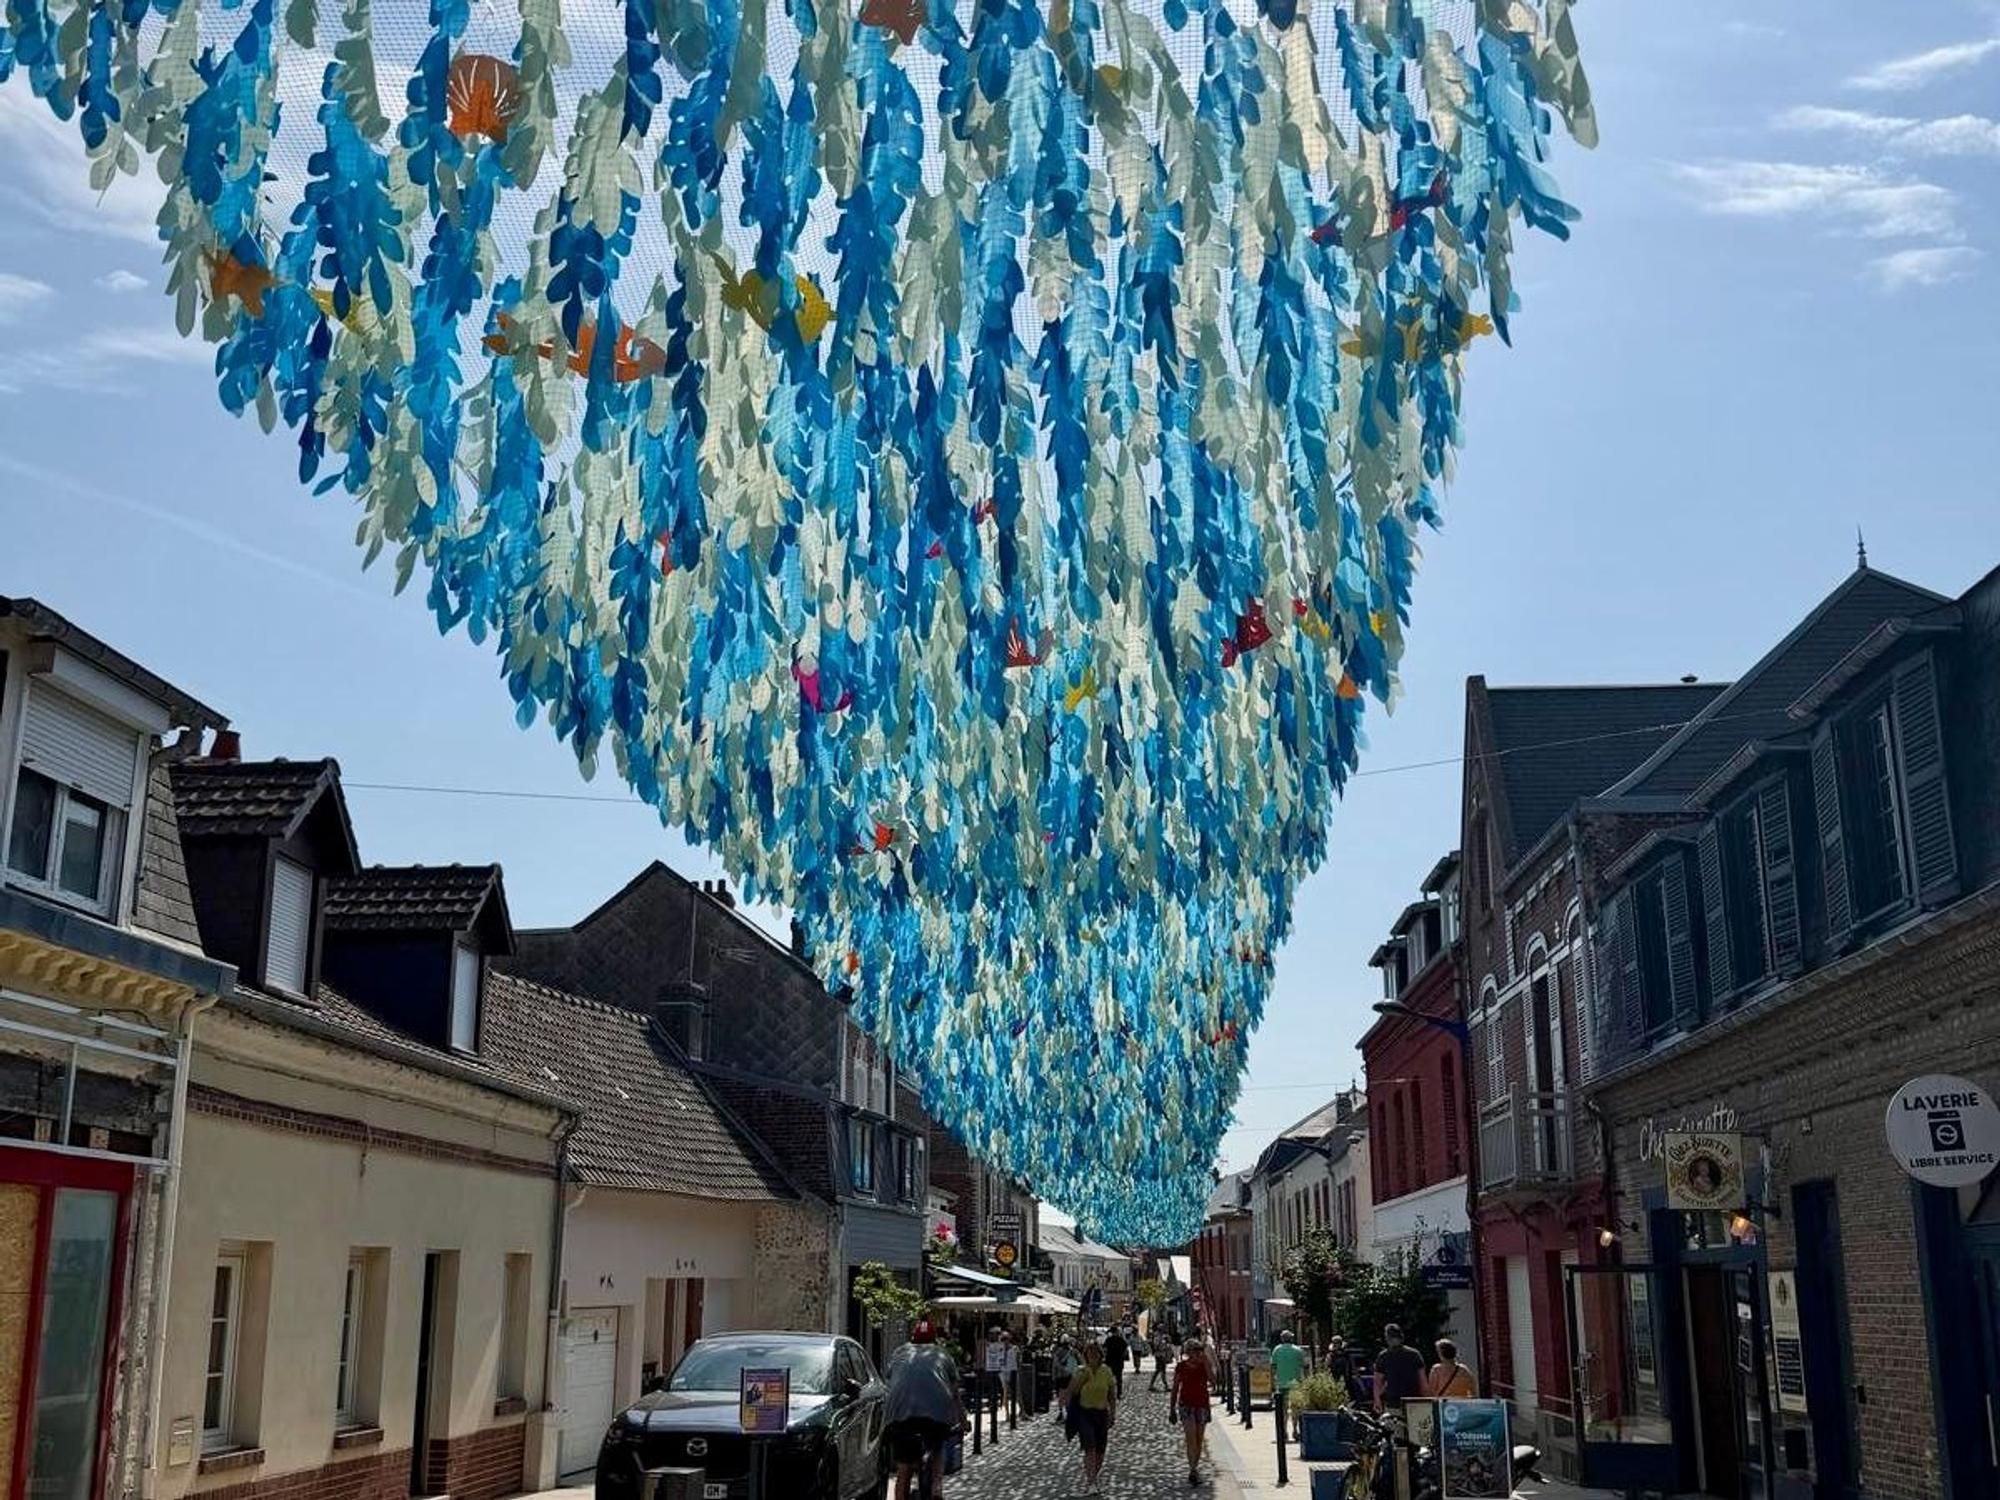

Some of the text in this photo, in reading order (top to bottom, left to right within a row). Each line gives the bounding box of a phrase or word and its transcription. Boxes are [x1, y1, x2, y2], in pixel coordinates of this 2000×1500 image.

[1903, 1093, 1979, 1111] LAVERIE
[1910, 1153, 1995, 1168] LIBRE SERVICE
